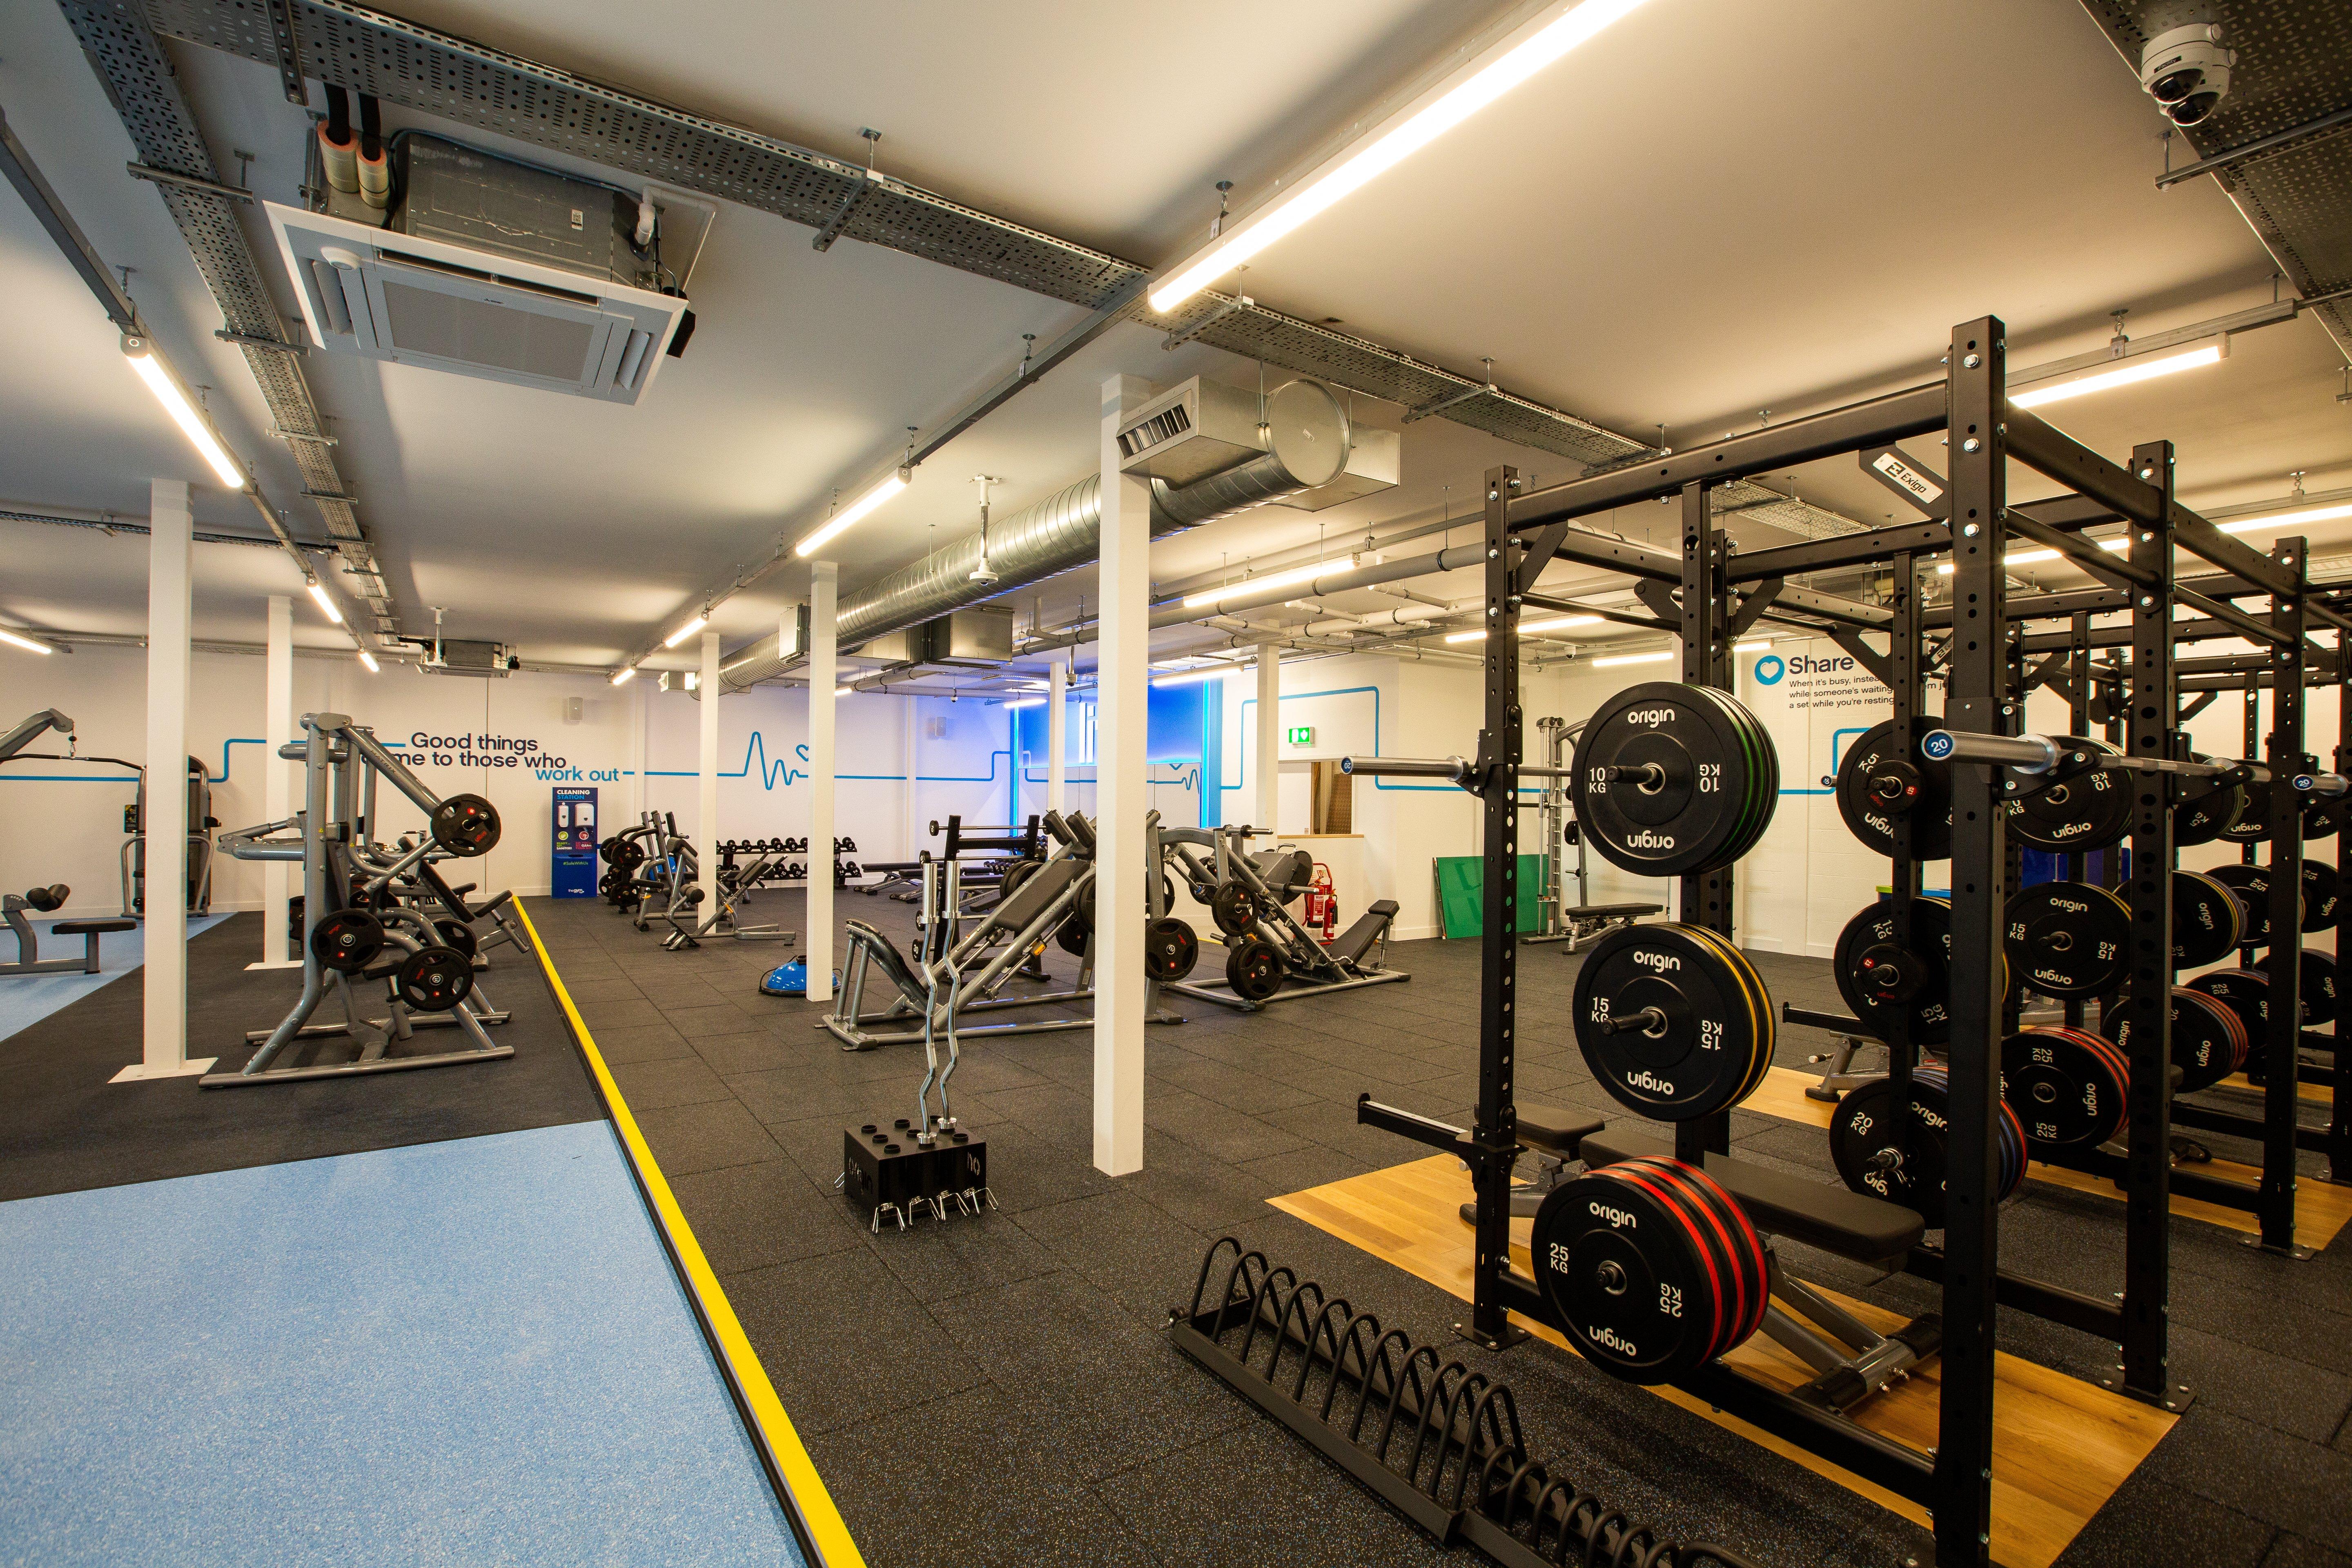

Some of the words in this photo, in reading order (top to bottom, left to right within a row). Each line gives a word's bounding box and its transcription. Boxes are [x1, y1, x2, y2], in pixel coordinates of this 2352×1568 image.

[1900, 472, 1927, 493] Exigo
[1789, 655, 1854, 674] Share
[1829, 677, 1851, 686] busy,
[1814, 688, 1858, 697] someone's
[1861, 686, 1893, 694] waiting
[1813, 699, 1834, 708] while
[1836, 699, 1862, 708] you're
[1864, 696, 1894, 705] resting
[1628, 709, 1675, 728] origin
[411, 732, 471, 749] Good
[478, 734, 538, 755] things
[1931, 739, 1948, 753] 20
[371, 750, 396, 773] MATRIX
[432, 752, 453, 766] to
[459, 751, 518, 767] those
[524, 753, 566, 768] who
[1868, 753, 1880, 765] 5
[535, 766, 584, 781] work
[589, 768, 619, 782] out
[1590, 767, 1606, 782] 10
[1699, 764, 1720, 776] KG
[2091, 772, 2109, 782] KG
[1589, 782, 1606, 793] KG
[1699, 777, 1720, 793] 10
[2094, 780, 2112, 791] 10
[2009, 806, 2025, 816] KG
[2195, 812, 2209, 824] KG
[1864, 812, 1893, 839] rigin
[2052, 822, 2092, 838] origin
[2190, 818, 2198, 827] 5
[2231, 823, 2262, 833] origin
[1627, 830, 1675, 849] origin
[2250, 878, 2261, 888] KG
[2308, 872, 2318, 880] 15
[1045, 901, 1064, 918] MATRIX
[2050, 898, 2089, 912] origin
[2321, 897, 2337, 915] origin
[2199, 903, 2214, 930] origin
[1873, 923, 1887, 940] KG
[2009, 931, 2025, 940] KG
[2011, 922, 2026, 933] 15
[913, 944, 919, 954] 30
[2097, 949, 2114, 960] 15
[2100, 942, 2117, 952] KG
[1634, 951, 1680, 973] origin
[2034, 969, 2072, 985] origin
[2211, 984, 2220, 995] KG
[2218, 984, 2230, 994] 25
[2323, 977, 2336, 998] origin
[1592, 996, 1609, 1013] 15
[1933, 1004, 1948, 1021] KG
[1920, 1008, 1938, 1025] 15
[1702, 1020, 1722, 1035] KG
[2118, 1021, 2131, 1046] origin
[1702, 1033, 1721, 1051] 15
[2032, 1047, 2042, 1061] KG
[2041, 1049, 2053, 1063] 25
[2196, 1040, 2212, 1067] origin
[1627, 1071, 1674, 1095] origin
[2082, 1082, 2098, 1116] origin
[1850, 1120, 1868, 1136] KG
[1854, 1112, 1873, 1129] 20
[2036, 1123, 2048, 1138] 25
[2048, 1125, 2058, 1138] KG
[1589, 1202, 1637, 1228] origin
[1550, 1243, 1569, 1262] 25
[1550, 1257, 1568, 1274] KG
[1661, 1283, 1681, 1302] KG
[1660, 1296, 1682, 1318] 25
[1589, 1325, 1637, 1356] origin
